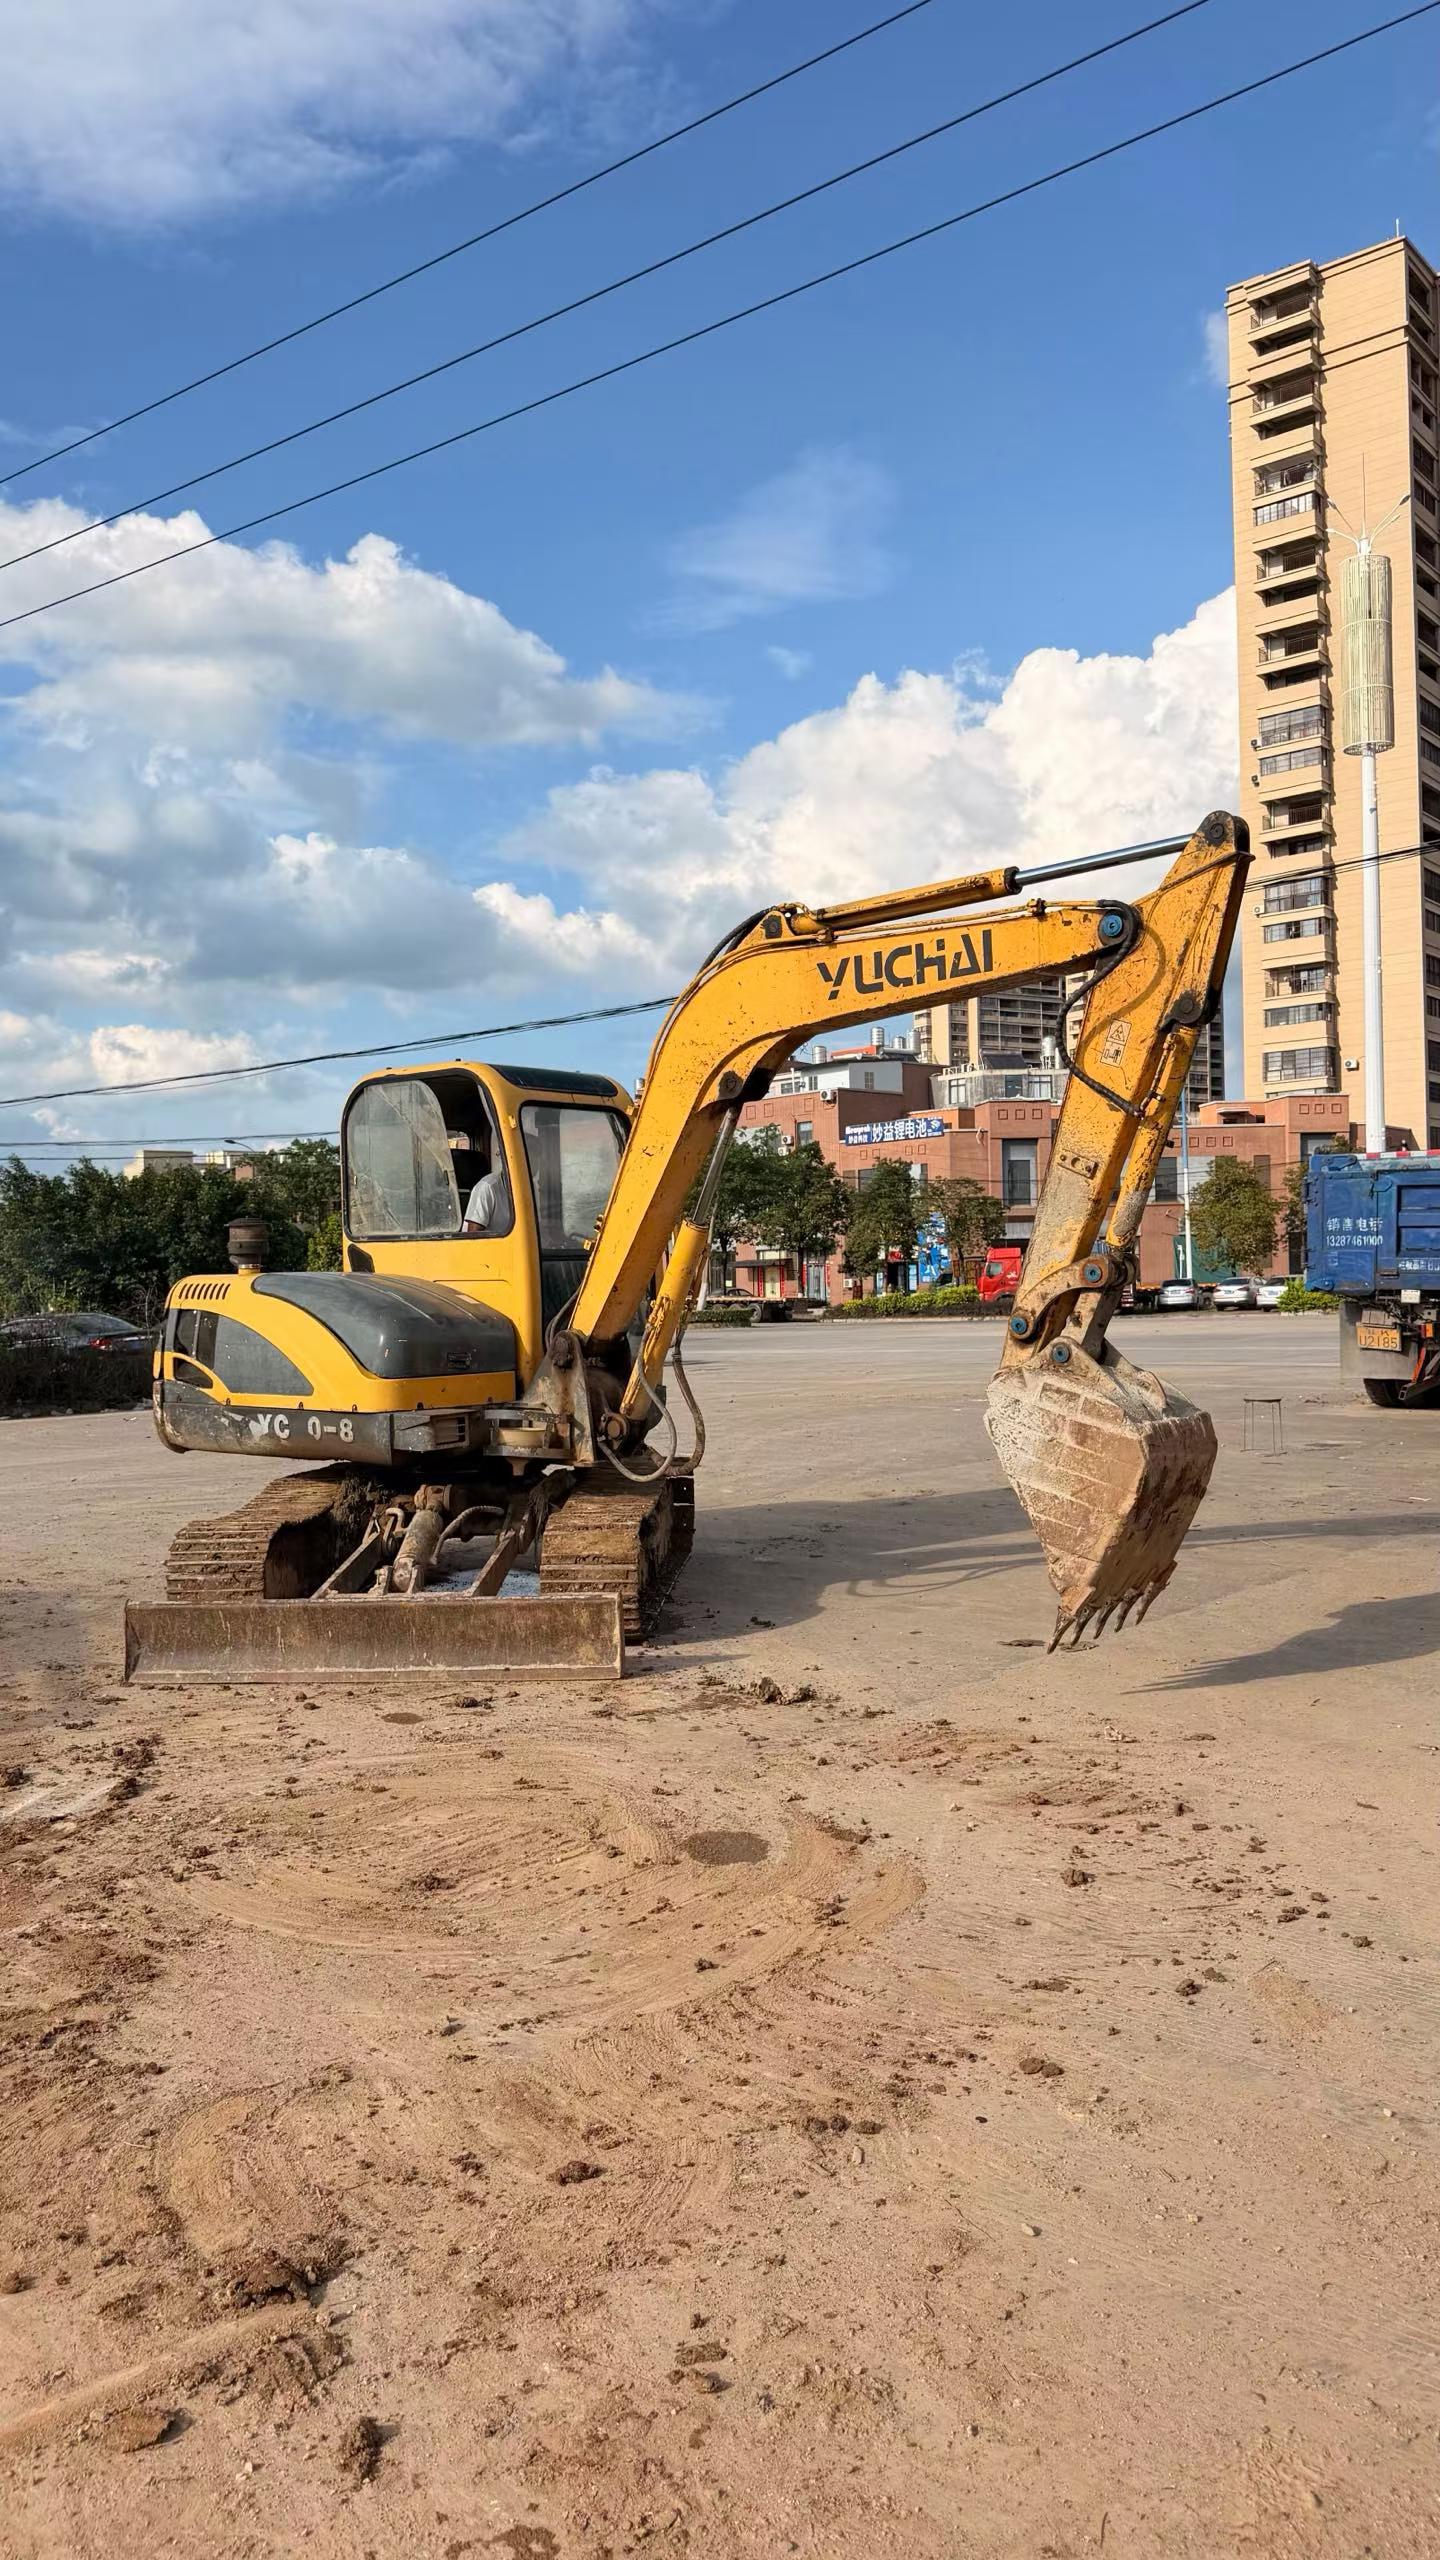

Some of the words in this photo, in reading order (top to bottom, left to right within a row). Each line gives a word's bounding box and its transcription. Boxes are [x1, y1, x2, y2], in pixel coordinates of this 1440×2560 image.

[816, 929, 994, 1001] YUCHAI
[872, 1118, 927, 1143] 妙益锂电池
[1326, 1217, 1383, 1231] 销售电话
[1359, 1335, 1398, 1349] U2185
